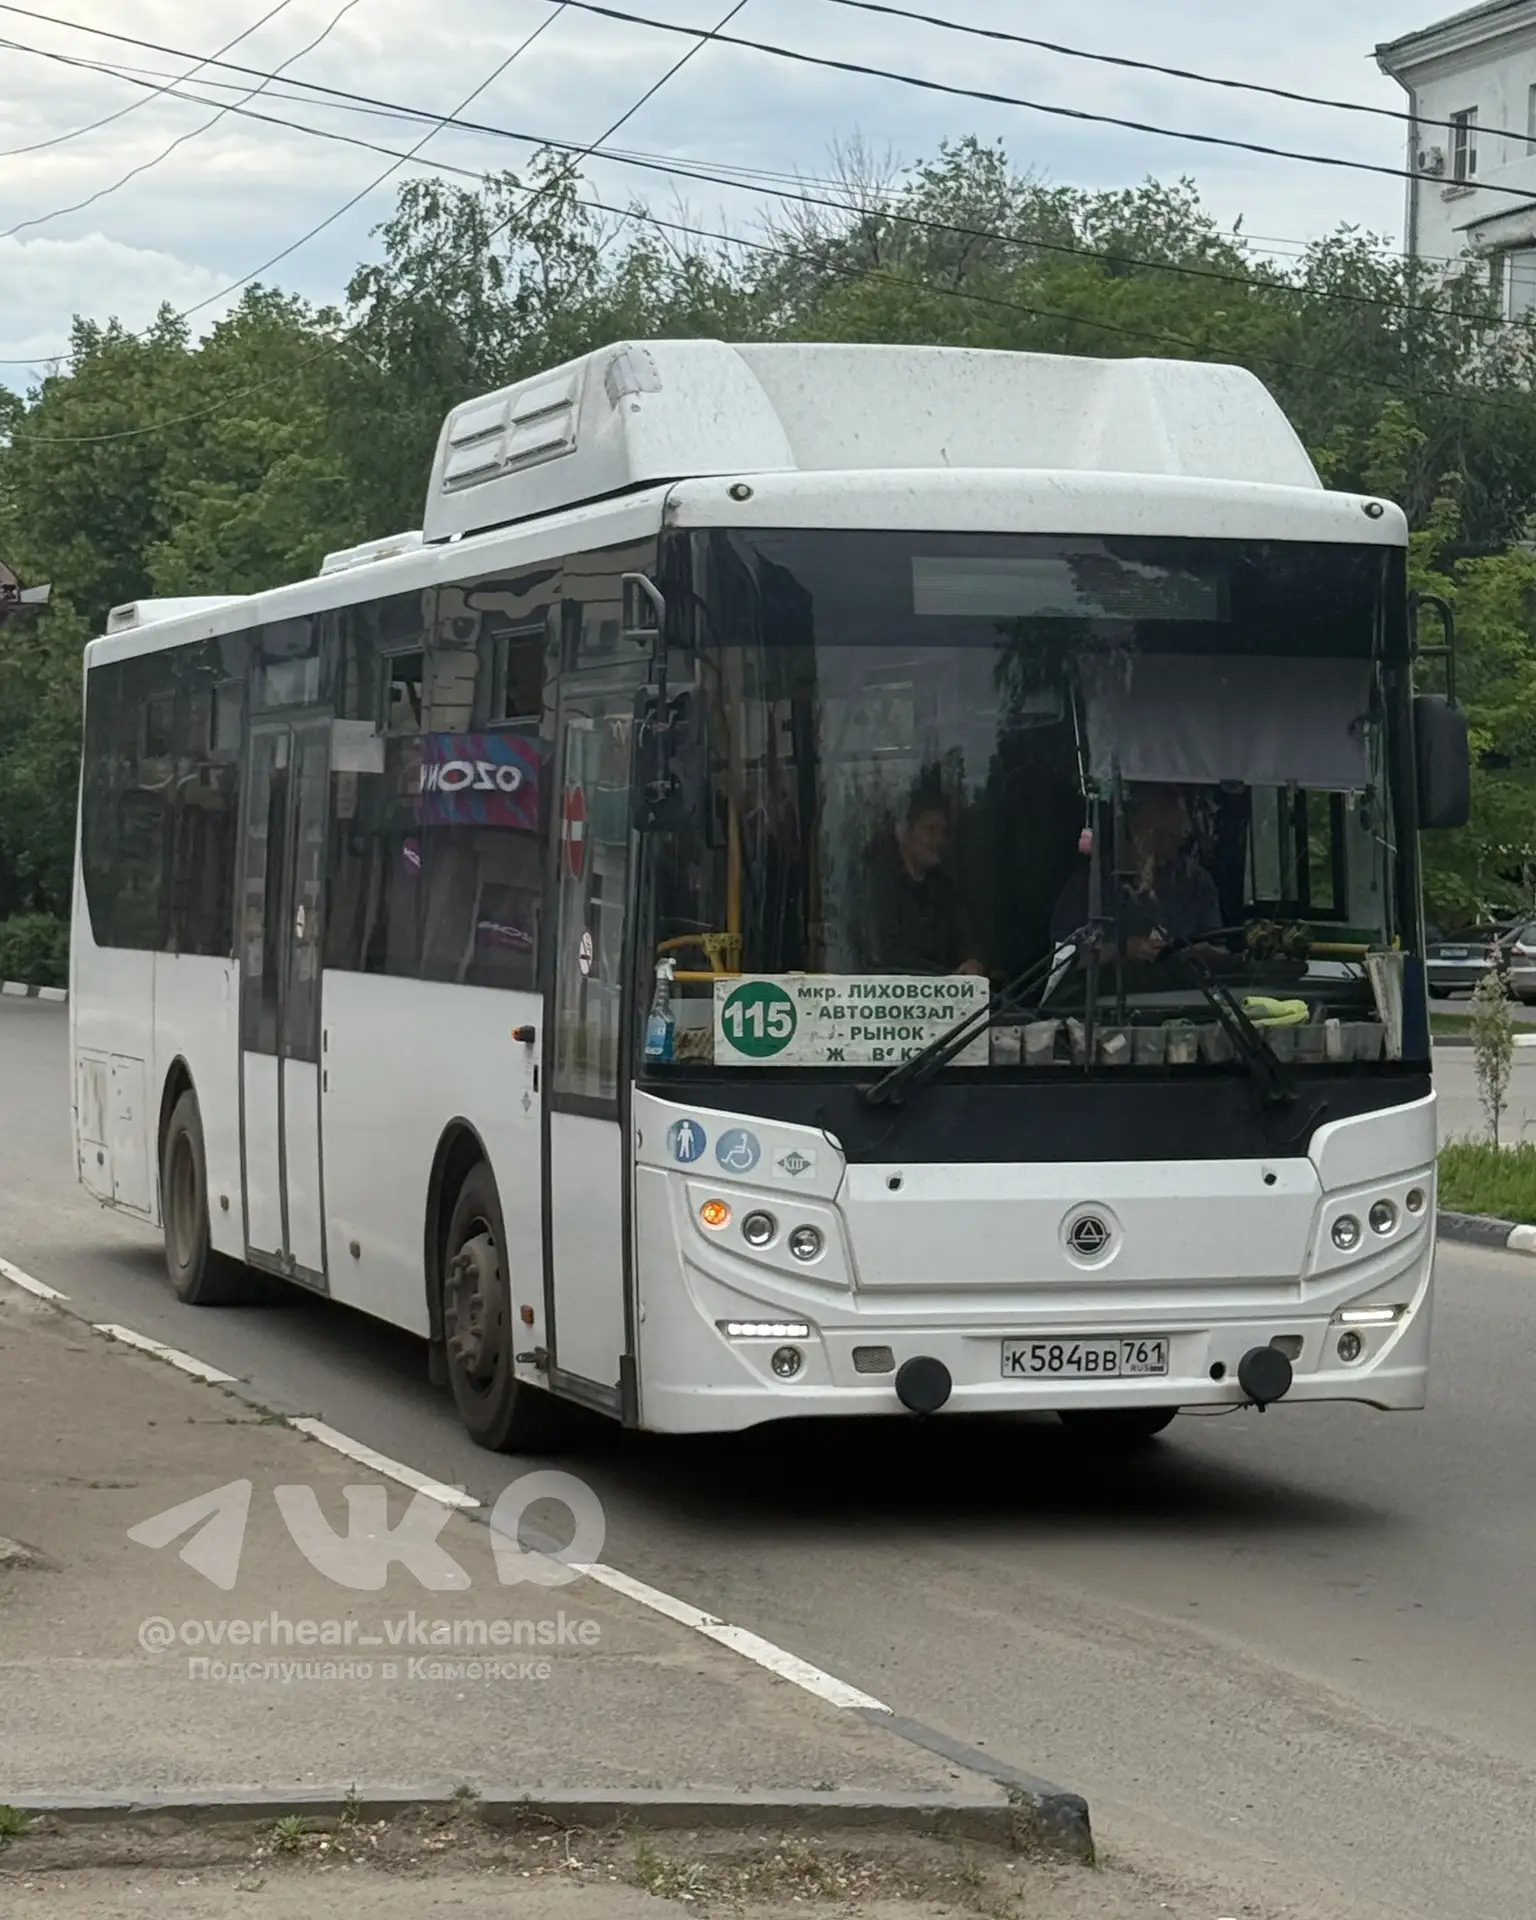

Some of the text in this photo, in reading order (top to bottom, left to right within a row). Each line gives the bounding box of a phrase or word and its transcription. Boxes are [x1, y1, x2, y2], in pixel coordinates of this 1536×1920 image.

[798, 987, 842, 1001] мкр.
[848, 981, 974, 999] ЛИХОВСКОЙ
[724, 1001, 793, 1039] 115
[818, 1006, 954, 1020] АВТОВОКЗАЛ
[850, 1027, 925, 1041] РЫНОК
[1123, 1341, 1162, 1363] 761
